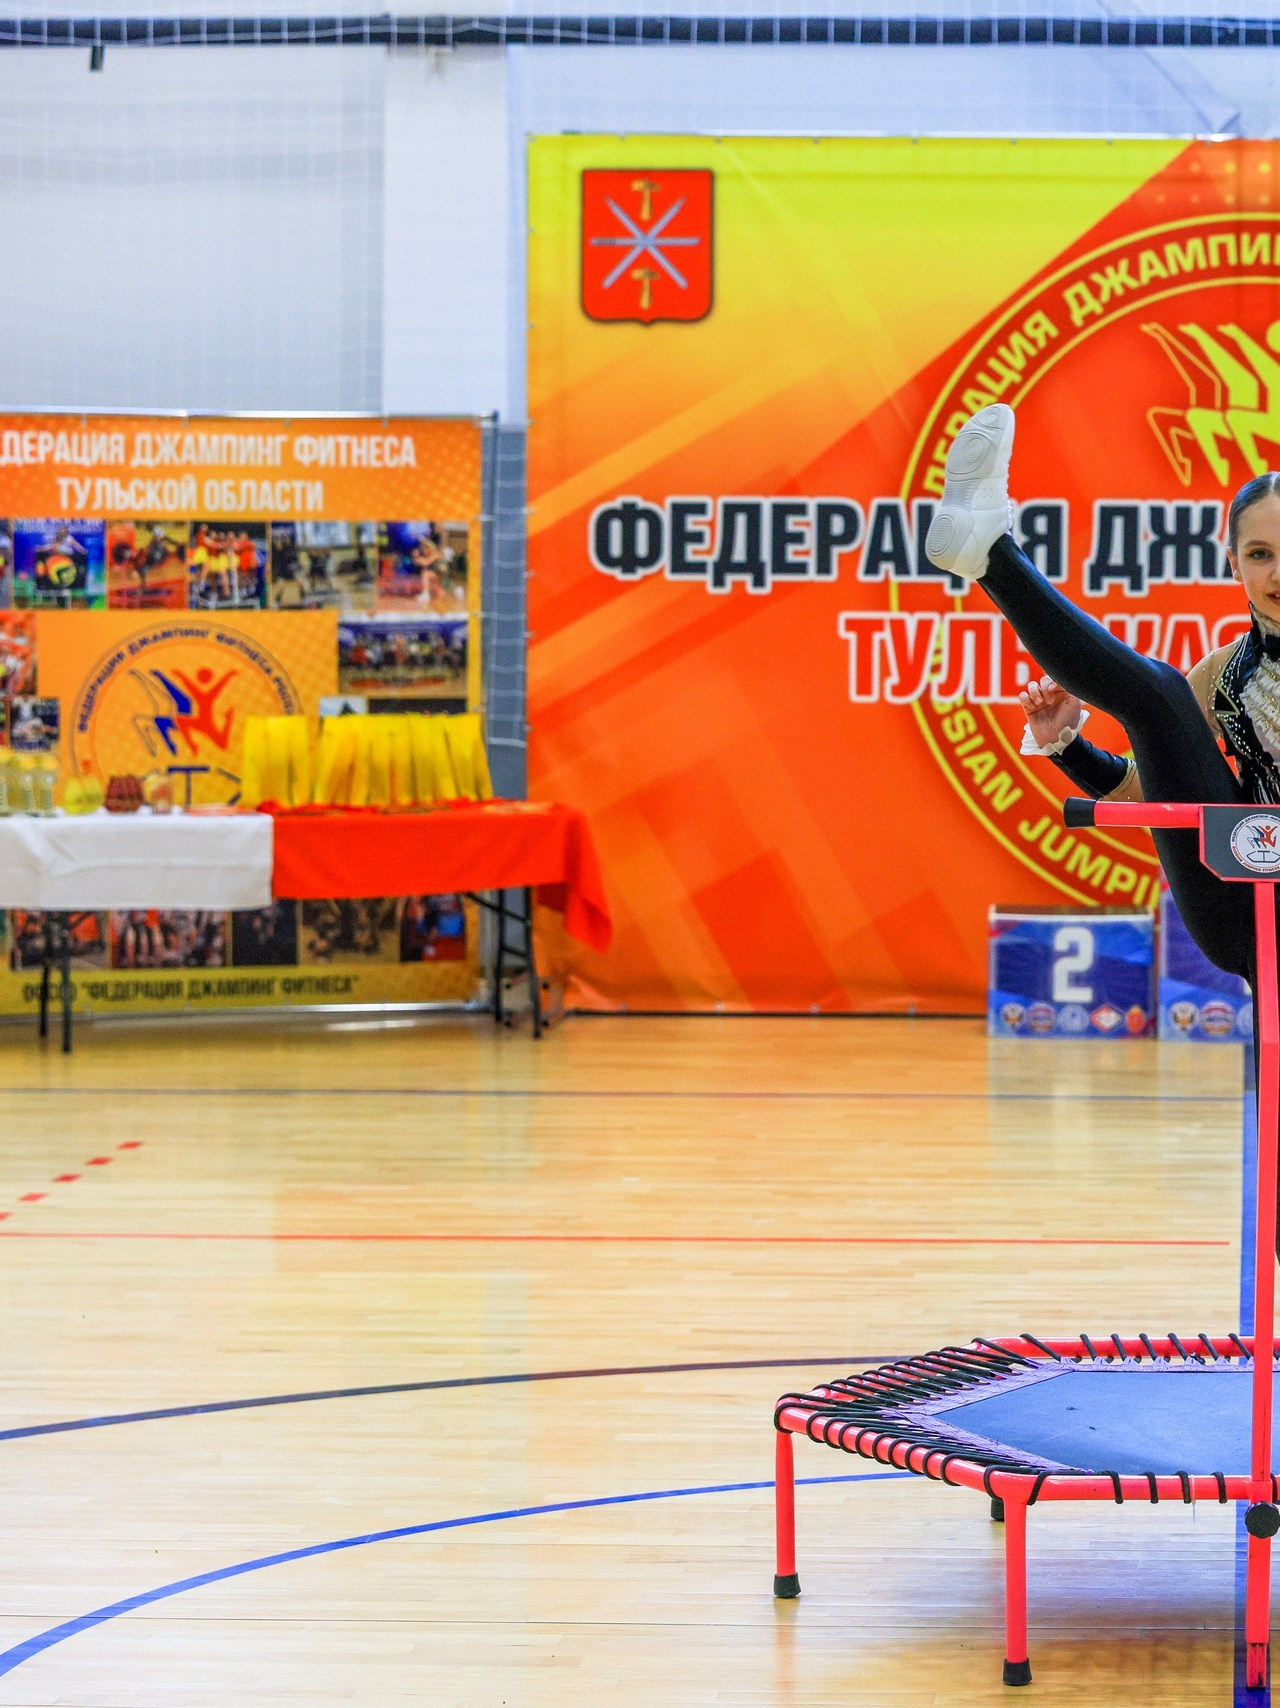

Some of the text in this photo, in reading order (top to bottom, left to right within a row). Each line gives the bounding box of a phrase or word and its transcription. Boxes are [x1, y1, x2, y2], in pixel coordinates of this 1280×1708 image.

[130, 432, 288, 468] ДЖАМПИНГ
[294, 435, 417, 468] ФИТНЕСА
[57, 474, 325, 512] ТУЛЬСКОЙ ОБЛАСТИ
[591, 497, 1067, 593] ФЕДЕРАЯ
[1016, 815, 1161, 909] JUMPI
[1053, 926, 1094, 1004] 2
